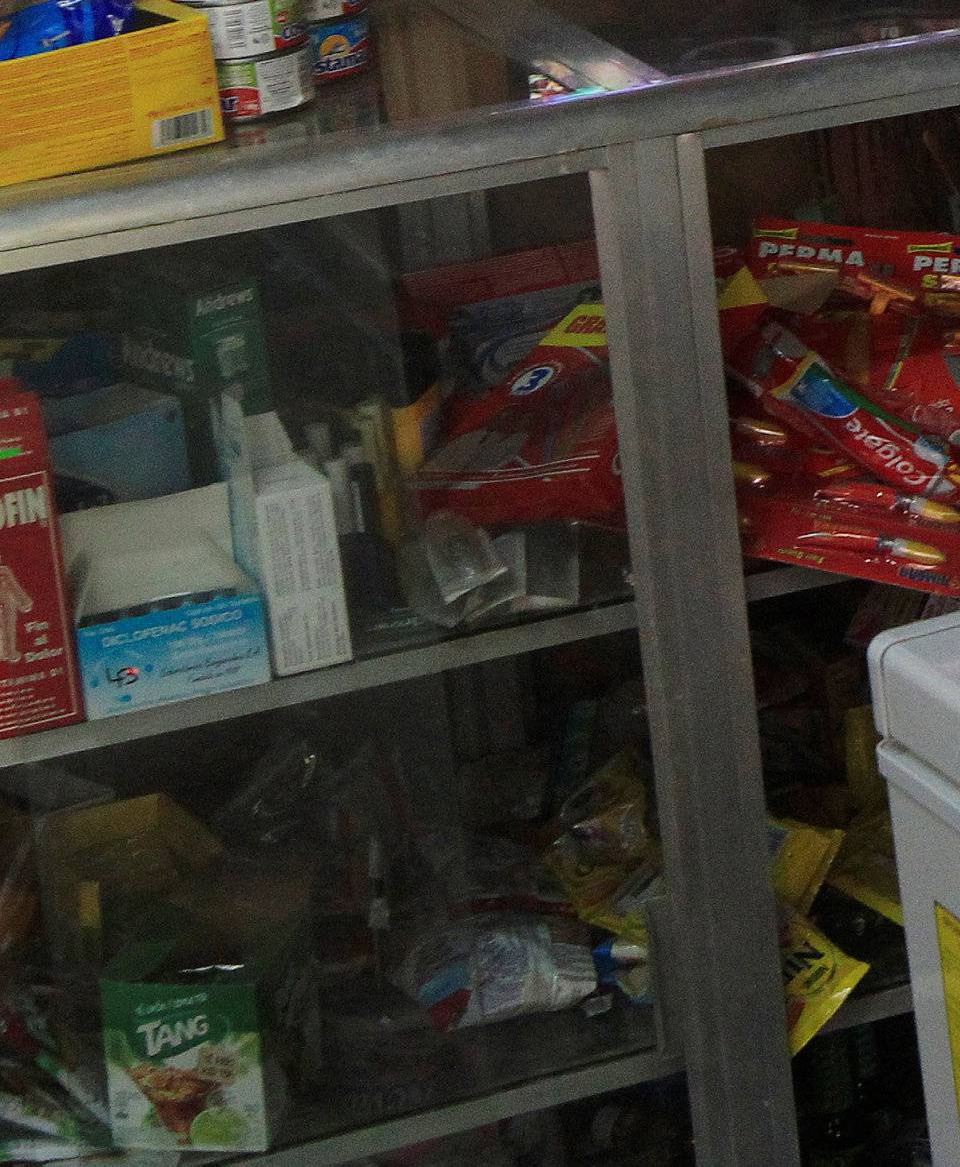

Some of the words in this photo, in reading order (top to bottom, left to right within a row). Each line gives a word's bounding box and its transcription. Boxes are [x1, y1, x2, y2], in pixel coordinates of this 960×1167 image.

[516, 368, 551, 393] 3
[844, 416, 932, 486] Colgate
[135, 1013, 210, 1058] TANG
